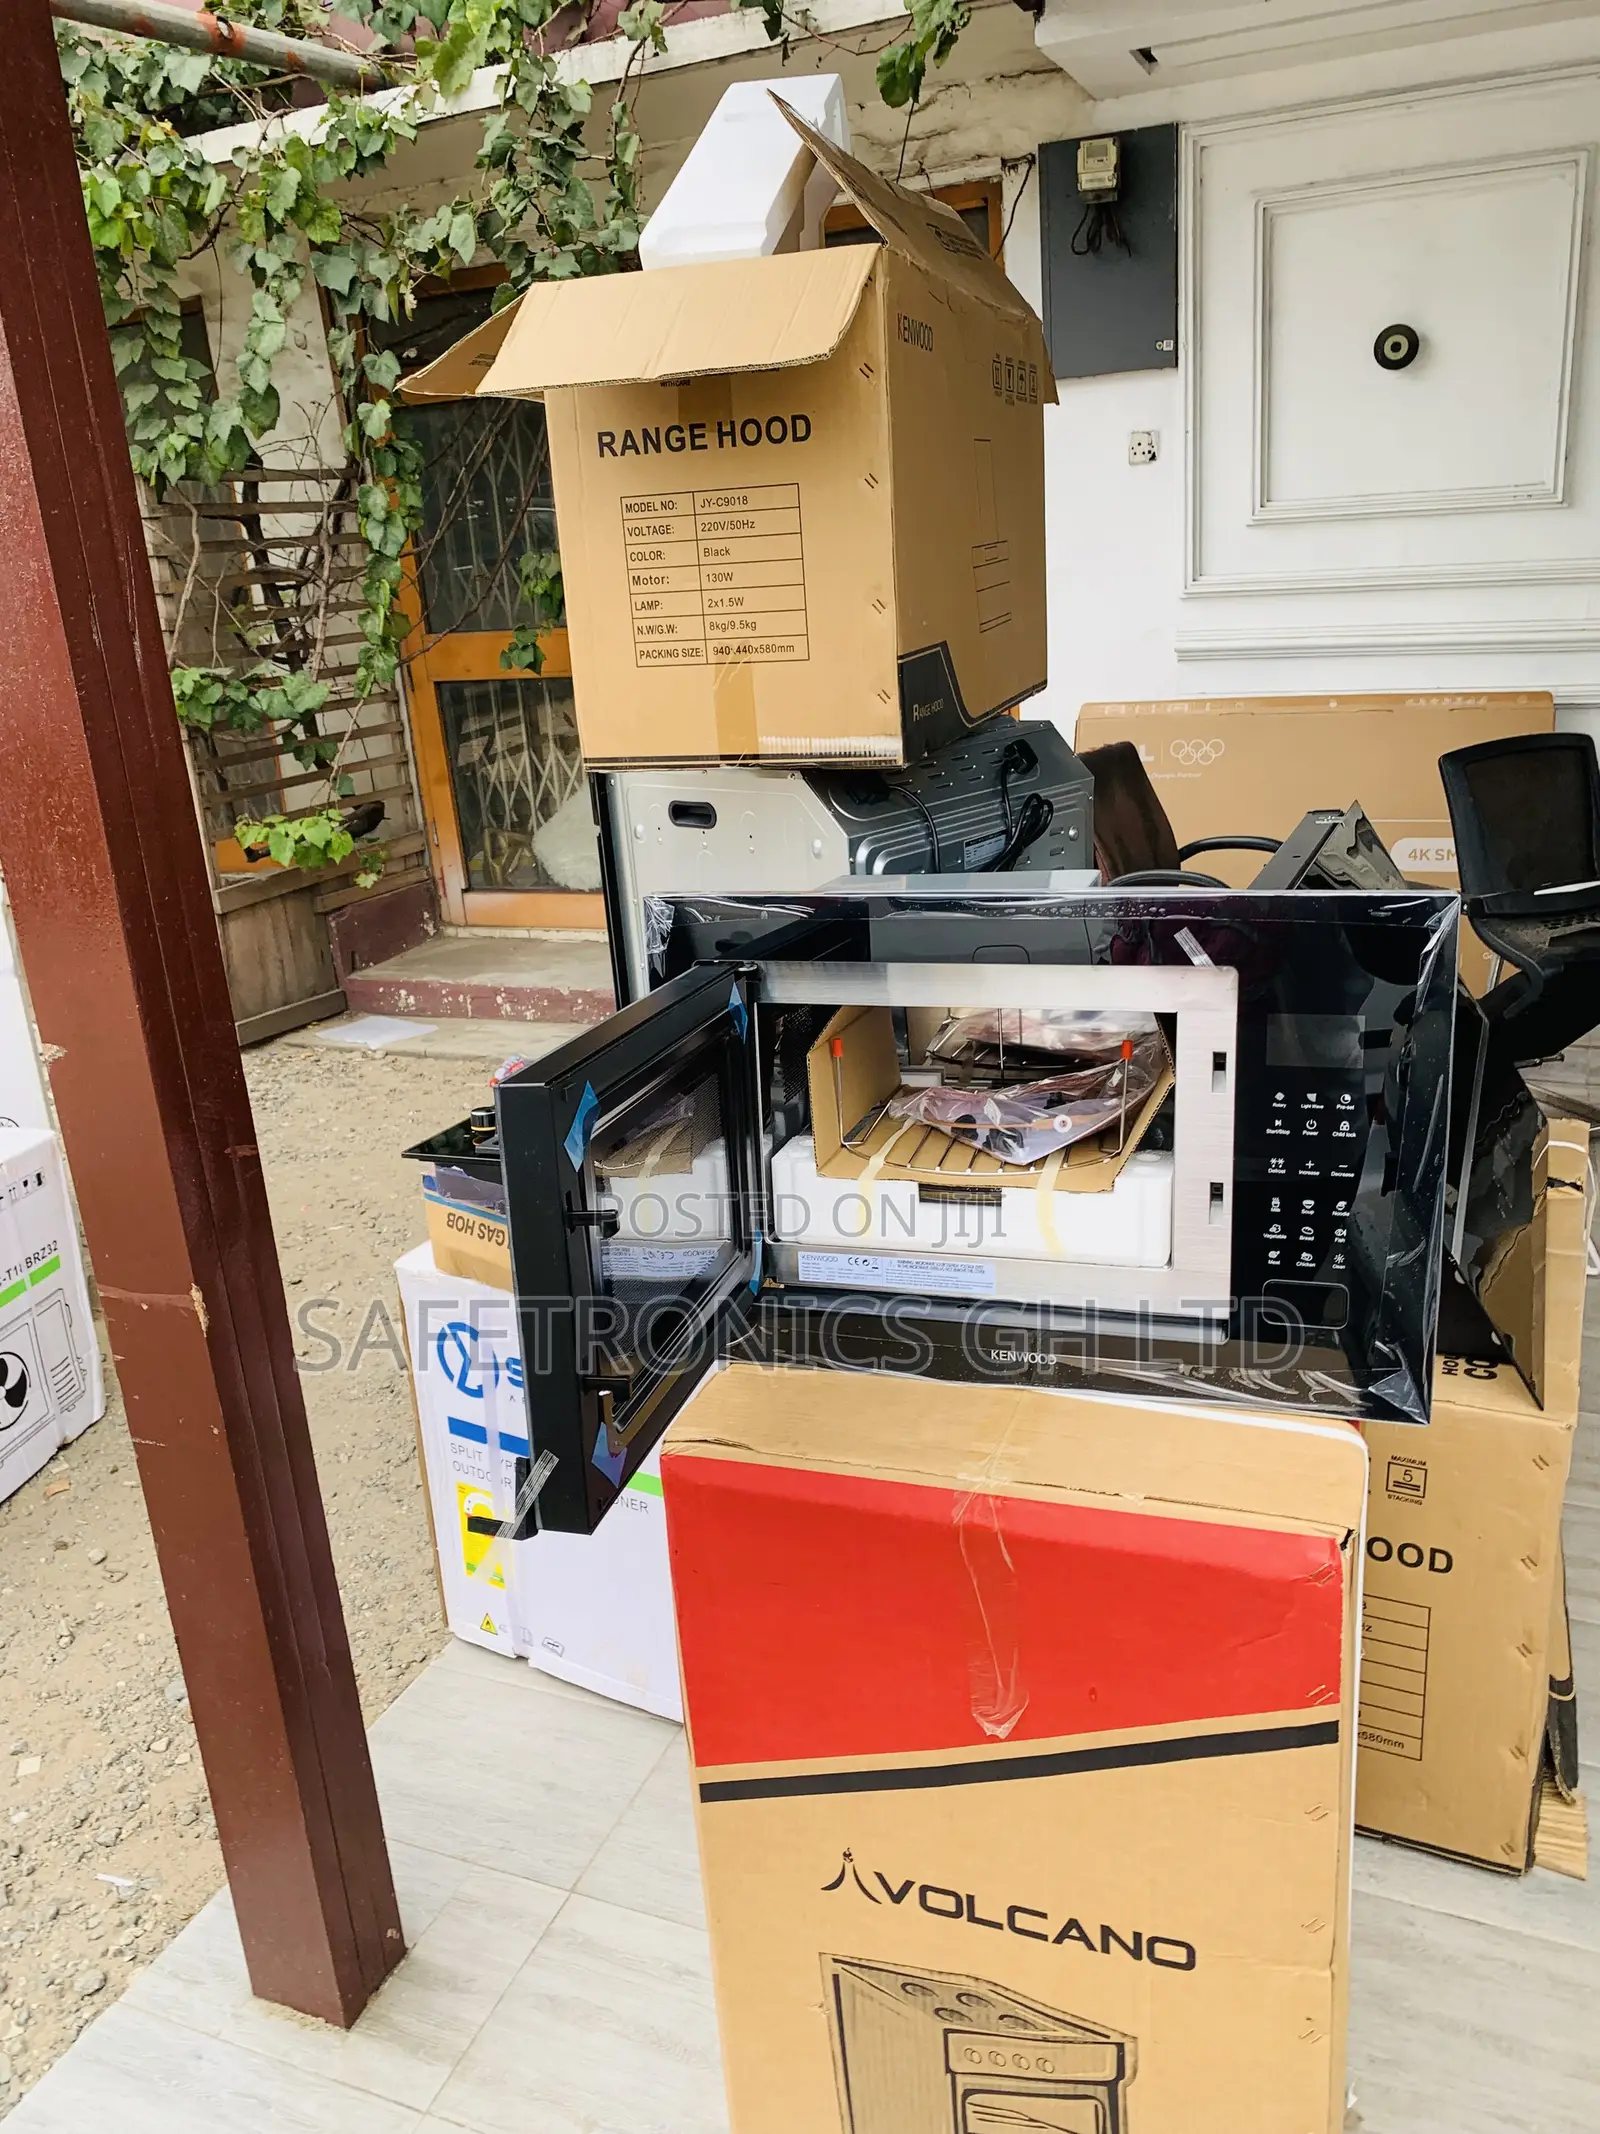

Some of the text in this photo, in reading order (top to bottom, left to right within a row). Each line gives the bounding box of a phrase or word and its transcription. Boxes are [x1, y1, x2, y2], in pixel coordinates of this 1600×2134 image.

[897, 313, 933, 352] KENWOOD
[597, 414, 811, 458] RANGE HOOD
[625, 496, 748, 513] MODEL NO: JY-C9018
[628, 520, 755, 537] VOLTAGE: 220V/50Hz
[630, 546, 730, 562] COLOR: Black
[632, 572, 733, 586] Motor: 130W
[635, 597, 744, 611] LAMP: 2x1.5W
[637, 620, 757, 635] N.W/G.W: 8kg/9.5kg
[640, 648, 679, 660] PACKING
[681, 648, 703, 658] SIZE:
[1408, 848, 1431, 861] 4K
[447, 1212, 505, 1246] GAS HOB
[802, 1254, 838, 1263] KENWOOD
[990, 1350, 1056, 1365] KENWOOD
[451, 1443, 482, 1462] SPLIT
[1391, 1454, 1427, 1466] MAXIMUM
[1403, 1469, 1413, 1482] 5
[1387, 1493, 1423, 1505] STACKING
[873, 1870, 1196, 1971] VOLCANO
